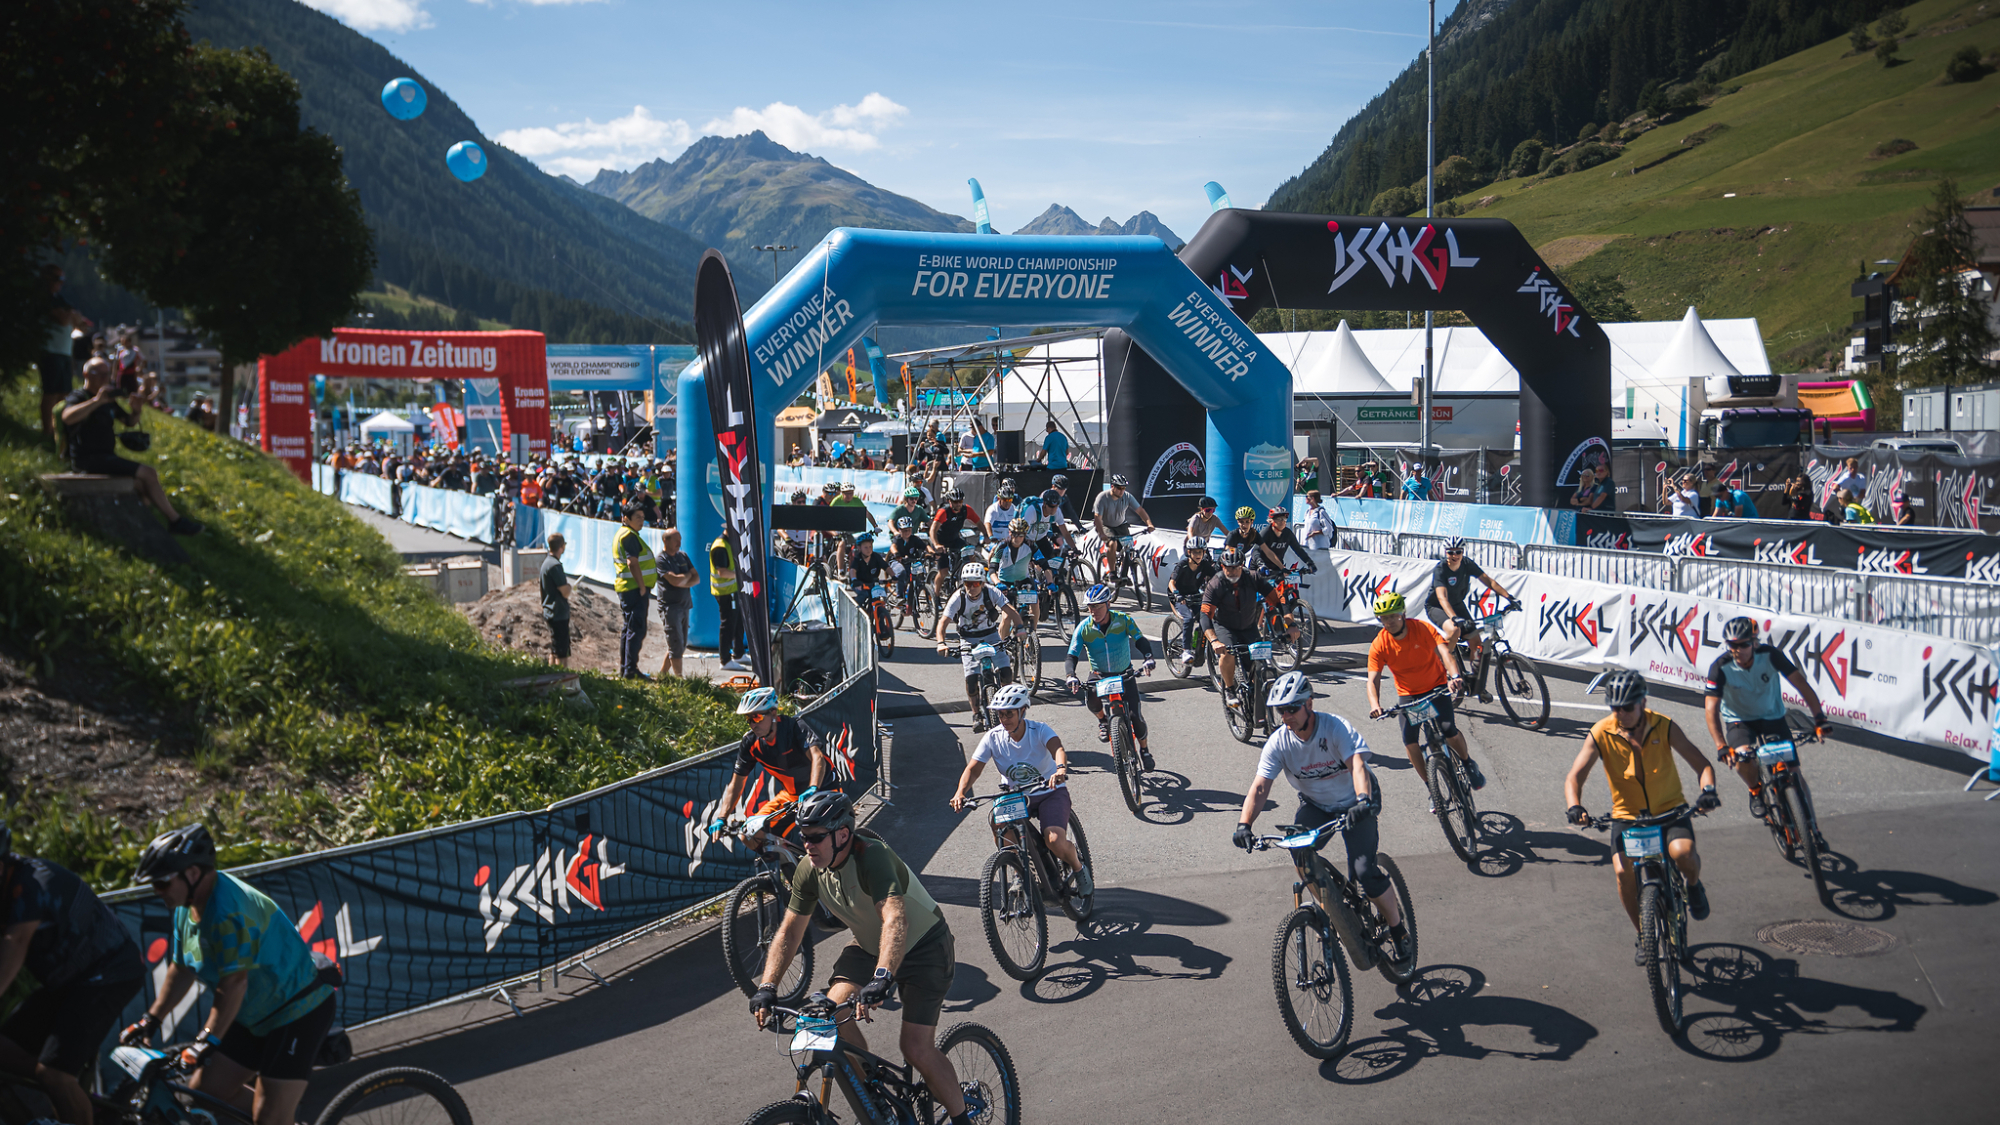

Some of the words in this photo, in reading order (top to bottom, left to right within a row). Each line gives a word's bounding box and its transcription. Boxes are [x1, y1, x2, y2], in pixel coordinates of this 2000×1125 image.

[919, 254, 962, 269] E-BIKE
[966, 256, 1014, 270] WORLD
[1017, 257, 1117, 271] CHAMPIONSHIP
[911, 271, 969, 298] FOR
[974, 273, 1114, 299] EVERYONE
[754, 294, 823, 365] EVERYONE
[823, 285, 837, 303] A
[1186, 291, 1249, 353] EVERYONE
[1245, 350, 1258, 363] A
[766, 298, 854, 387] WINNER
[1167, 302, 1249, 382] WINNER
[320, 337, 406, 366] Kronen
[410, 339, 497, 372] Zeitung
[550, 361, 579, 369] WORLD
[270, 380, 303, 392] Kronen
[514, 386, 544, 397] Kronen
[271, 393, 303, 406] Zeitung
[515, 397, 545, 409] Zeitung
[1360, 409, 1416, 418] GETRÄNKE
[271, 434, 304, 446] Kronen
[1256, 481, 1284, 494] WM
[1479, 519, 1504, 530] E-BIKE
[1479, 529, 1513, 541] WORLD
[1649, 660, 1676, 676] Relax.
[1826, 703, 1845, 718] you
[1847, 709, 1867, 721] can
[1944, 730, 1983, 751] Relax.
[1002, 805, 1017, 814] 235
[842, 1064, 878, 1120] S-WORKS
